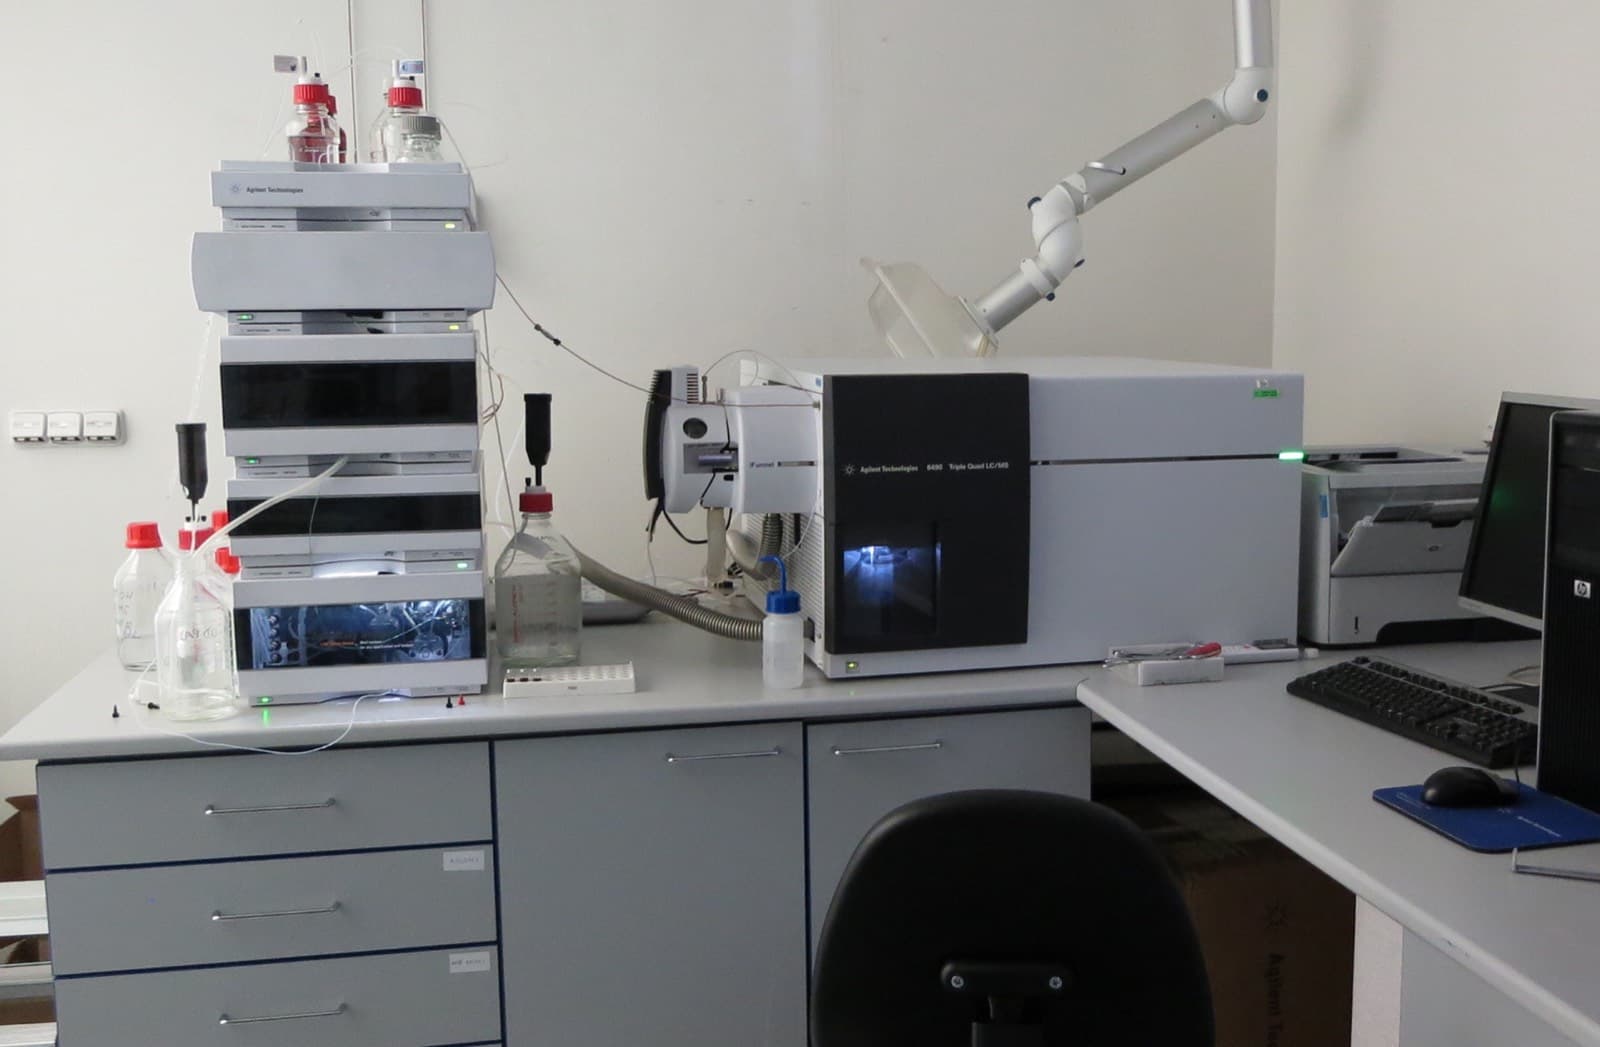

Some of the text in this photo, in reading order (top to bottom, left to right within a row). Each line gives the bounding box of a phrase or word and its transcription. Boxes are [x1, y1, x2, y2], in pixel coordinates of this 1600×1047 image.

[247, 186, 303, 194] Agilent Technologies
[860, 466, 882, 474] Agilent
[882, 465, 919, 473] Technologies
[949, 463, 966, 471] Triple
[967, 462, 985, 470] Quad
[985, 461, 1010, 469] LC/MS
[1264, 953, 1286, 1016] Agilent
